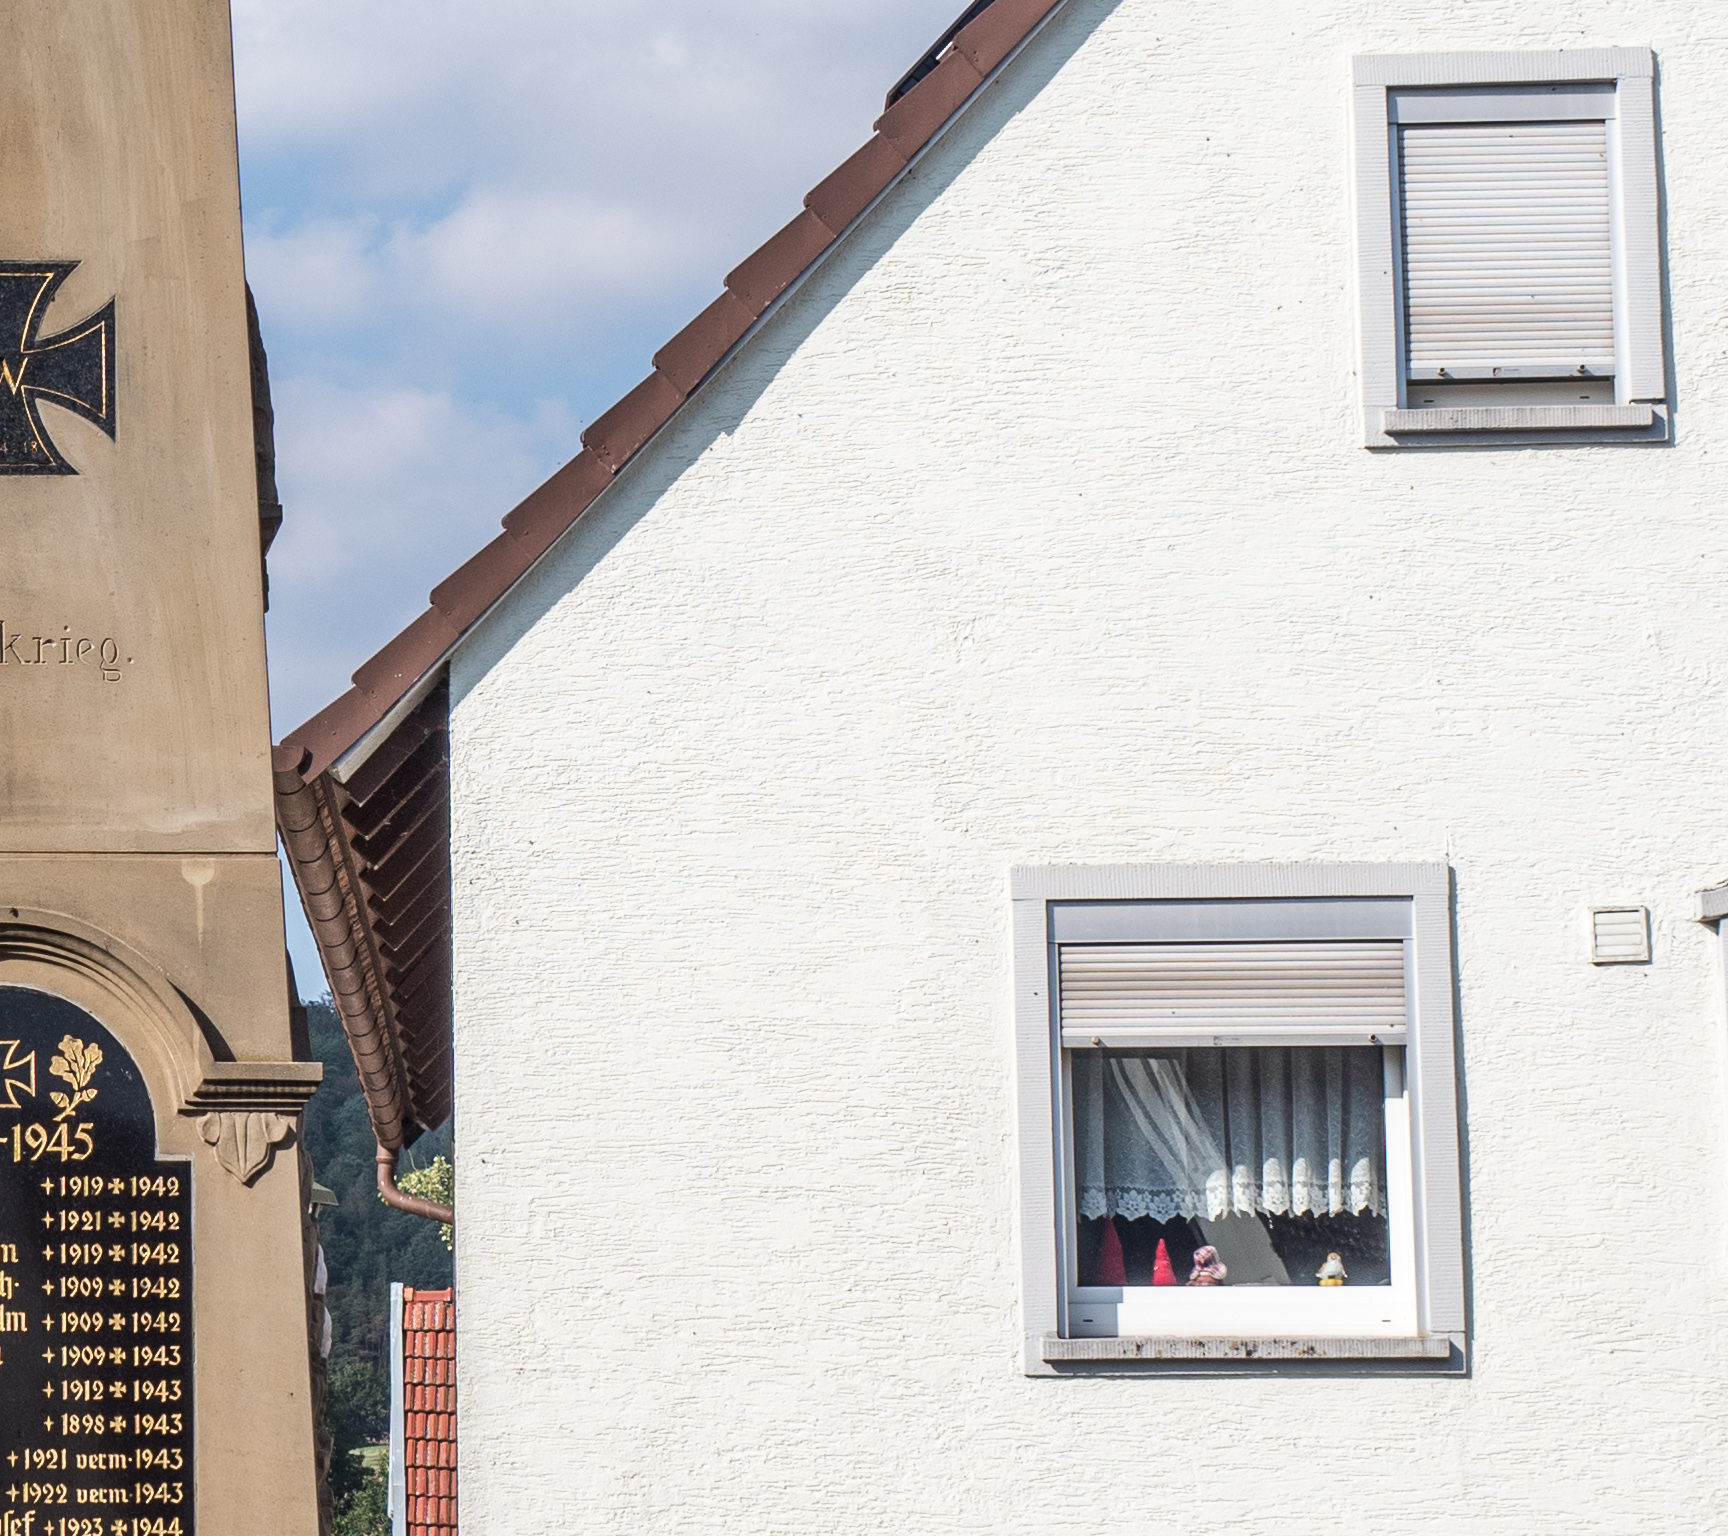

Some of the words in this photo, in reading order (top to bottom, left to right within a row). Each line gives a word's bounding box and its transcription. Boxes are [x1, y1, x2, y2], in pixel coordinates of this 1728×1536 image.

[59, 1175, 104, 1197] 1919
[129, 1175, 180, 1197] 1942
[59, 1209, 101, 1232] 1921
[130, 1210, 180, 1233] 1942
[60, 1242, 103, 1266] 1919
[130, 1242, 180, 1266] 1942
[59, 1275, 104, 1298] 1909
[132, 1276, 181, 1299] 1942
[60, 1311, 104, 1334] 1909
[131, 1311, 181, 1334] 1942
[61, 1345, 106, 1367] 1909
[133, 1345, 182, 1367] 1943
[61, 1379, 104, 1402] 1912
[133, 1379, 182, 1403] 1943
[60, 1412, 105, 1436] 1898
[134, 1413, 183, 1436] 1943
[24, 1447, 67, 1470] 1921
[135, 1448, 184, 1471] 1943
[22, 1481, 68, 1505] 1922
[134, 1482, 184, 1505] 1943
